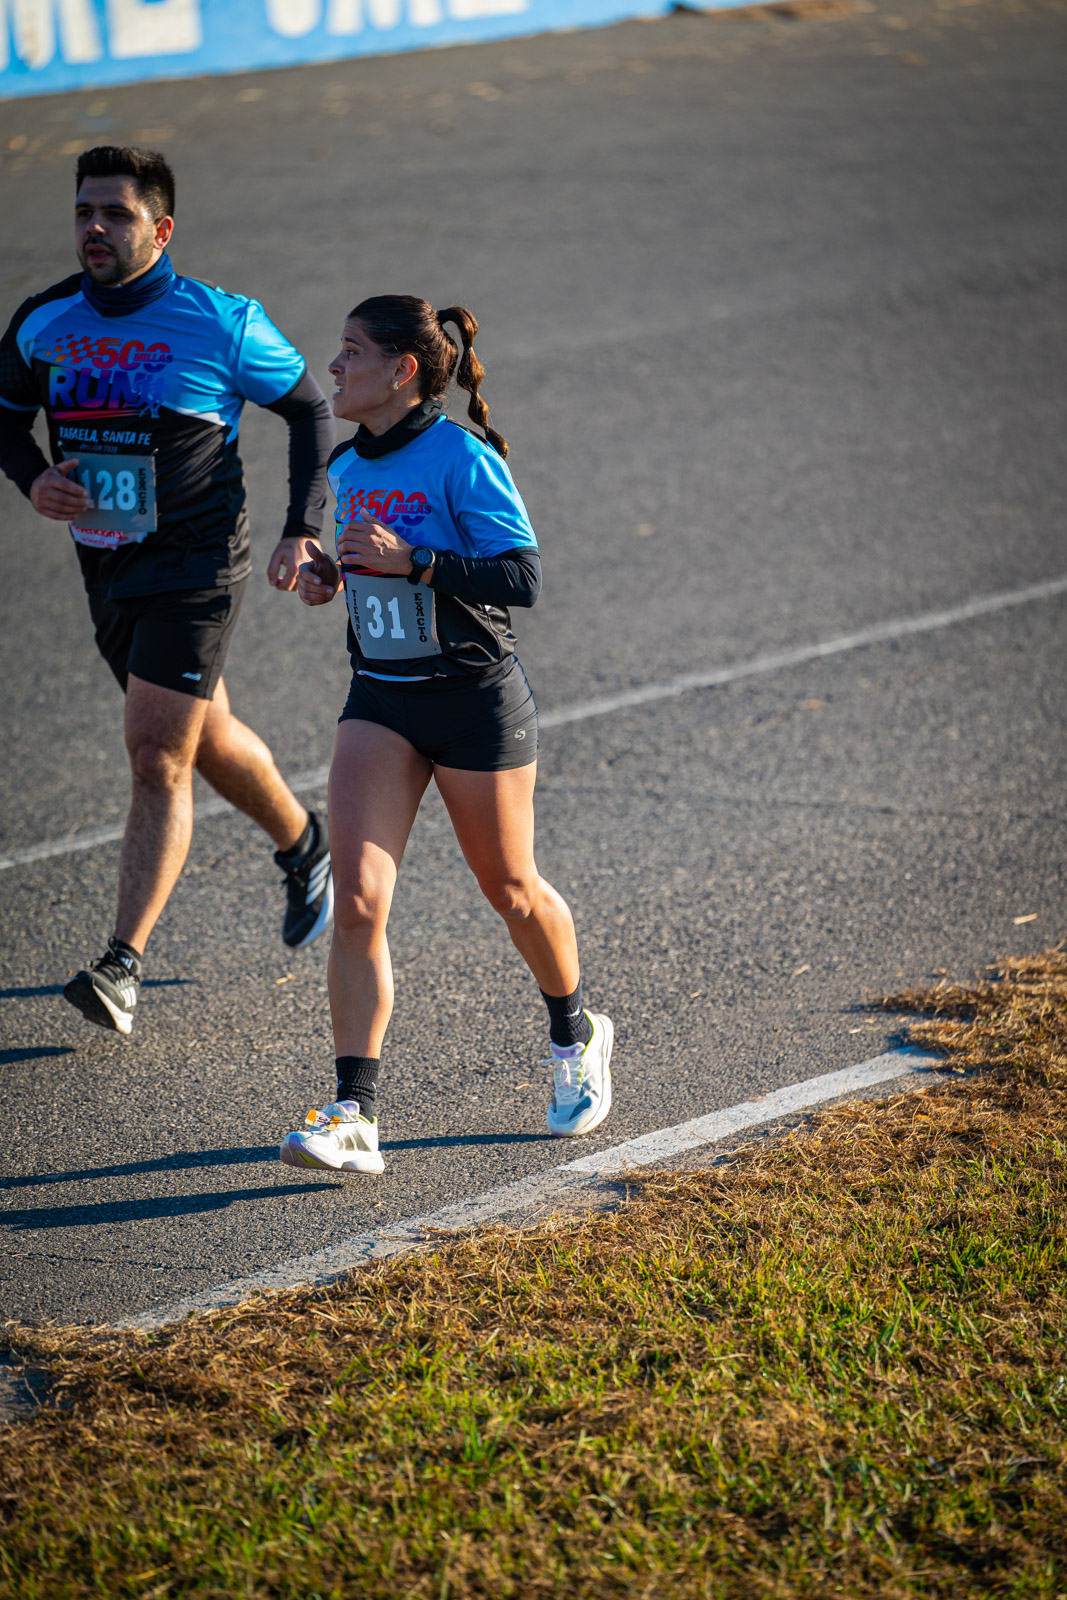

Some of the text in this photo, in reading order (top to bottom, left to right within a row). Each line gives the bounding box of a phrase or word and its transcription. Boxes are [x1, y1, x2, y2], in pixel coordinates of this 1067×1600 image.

[133, 352, 174, 363] MILLAS
[102, 430, 137, 444] SANTA
[137, 433, 152, 445] FE
[80, 467, 147, 515] 128 EXACTO
[392, 504, 432, 515] MILLAS
[366, 595, 406, 639] 31
[414, 592, 428, 643] EXACTO
